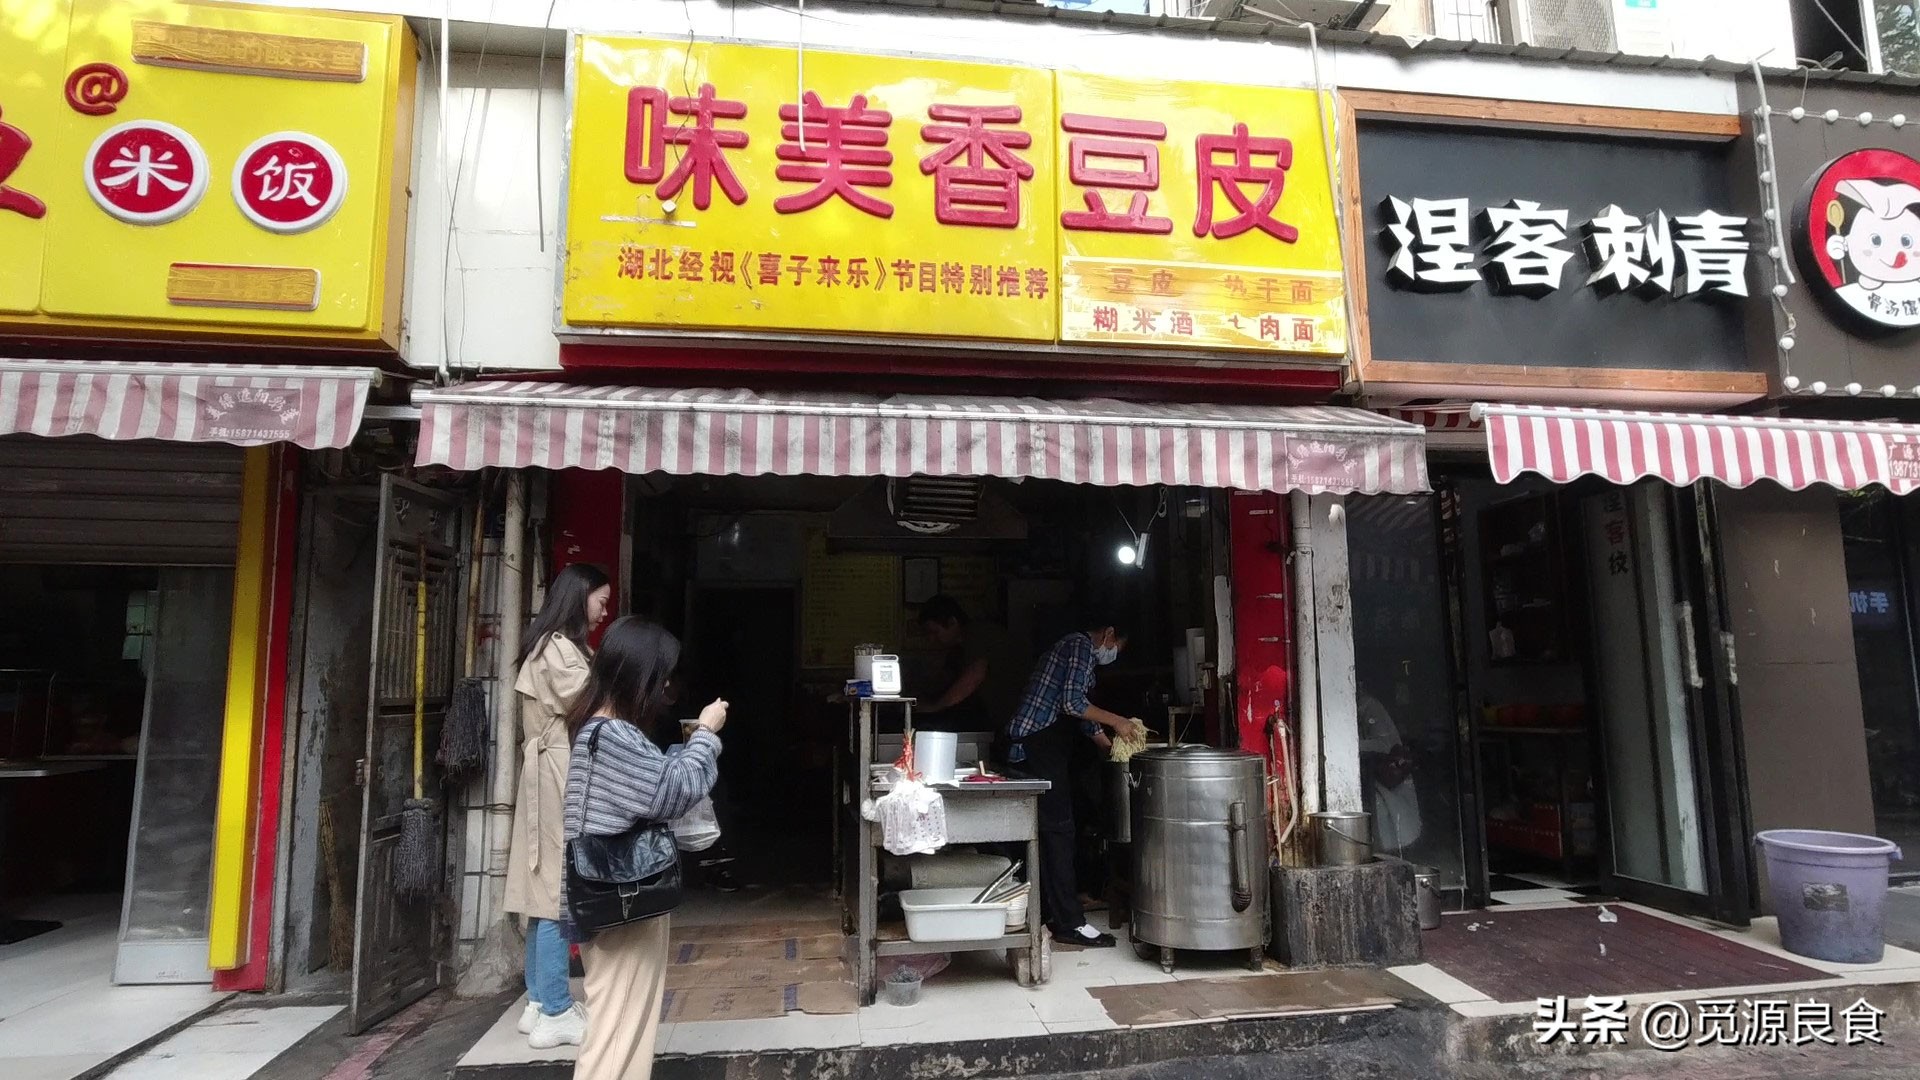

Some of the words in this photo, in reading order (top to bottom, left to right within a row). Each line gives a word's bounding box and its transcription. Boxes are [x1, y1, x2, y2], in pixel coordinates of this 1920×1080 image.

[101, 144, 321, 207] 米饭
[622, 82, 1299, 243] 味美香豆皮
[617, 247, 1050, 301] 湖北经视《喜子来乐》节目特别推荐
[1386, 194, 1749, 298] 涅客刺青
[1110, 267, 1174, 295] 豆皮
